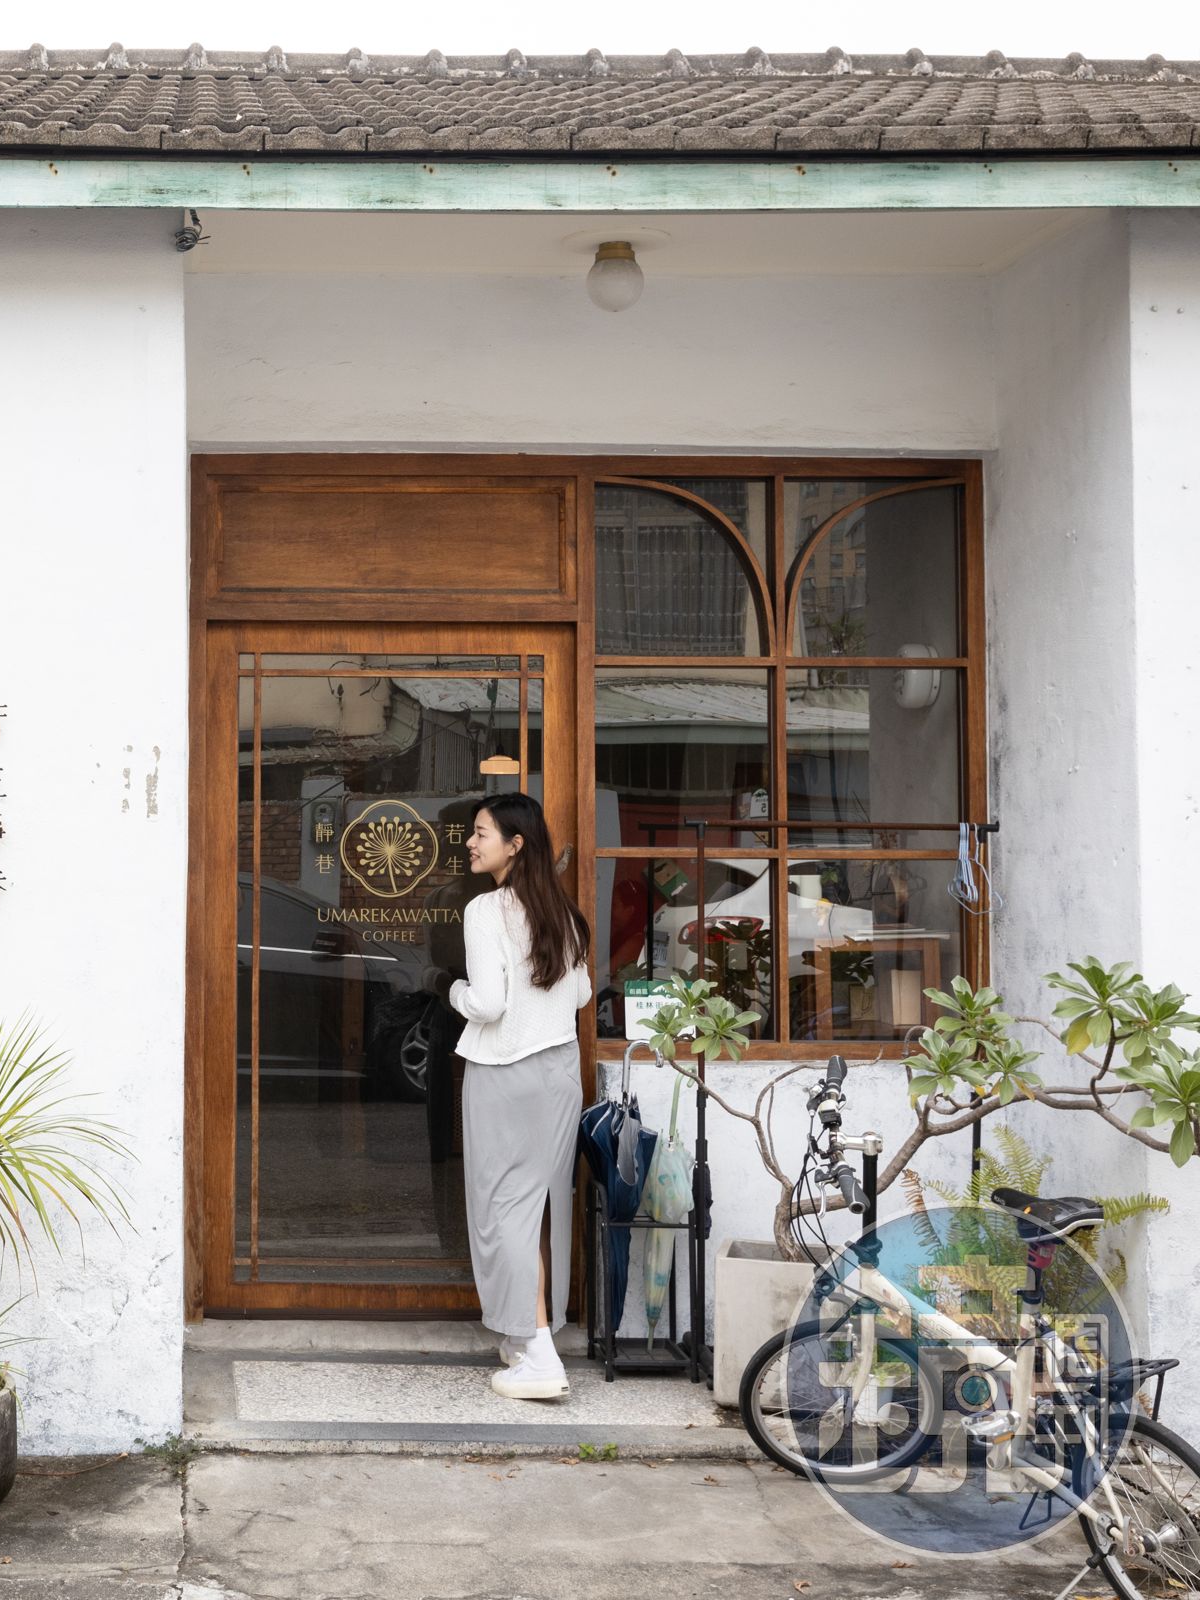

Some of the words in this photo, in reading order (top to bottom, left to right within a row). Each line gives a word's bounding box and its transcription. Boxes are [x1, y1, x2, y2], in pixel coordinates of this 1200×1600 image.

[315, 822, 335, 874] 靜巷
[444, 823, 465, 876] 若生
[317, 908, 462, 924] UMAREKAWATTA
[362, 930, 416, 942] COFFEE
